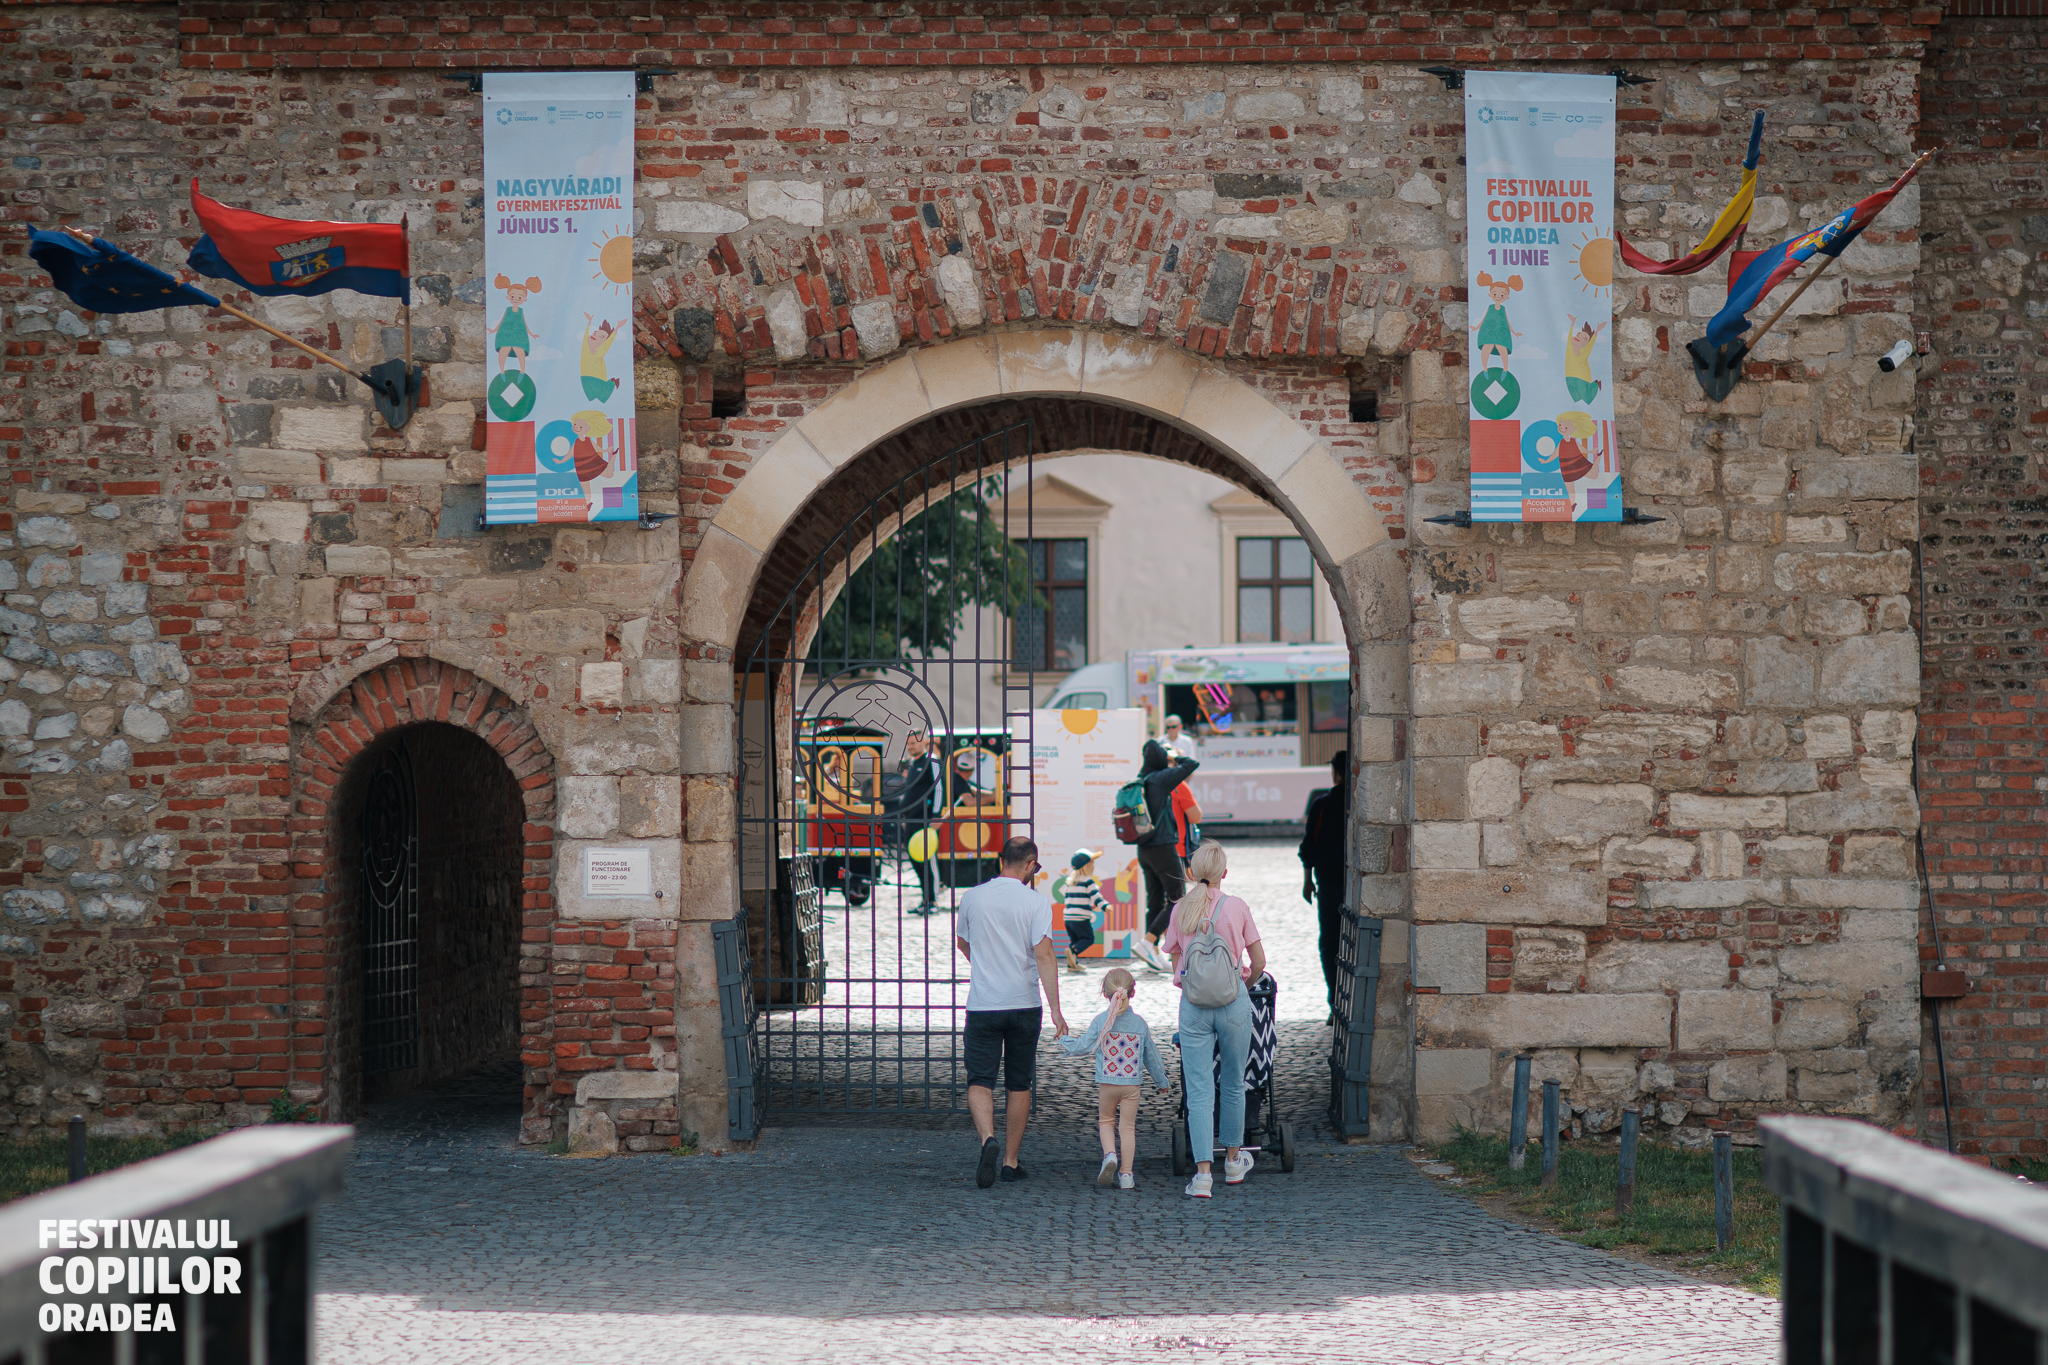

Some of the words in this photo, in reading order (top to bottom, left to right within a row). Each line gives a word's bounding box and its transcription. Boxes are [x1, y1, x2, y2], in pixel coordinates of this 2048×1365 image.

[496, 175, 622, 196] NAGYVÁRADI
[1486, 178, 1592, 198] FESTIVALUL
[496, 196, 622, 212] GYERMEKFESZTIVÁL
[1487, 200, 1594, 224] COPIILOR
[497, 215, 560, 234] JÚNIUS
[564, 218, 578, 234] 1.
[1487, 226, 1560, 245] ORADEA
[1488, 249, 1497, 266] 1
[1502, 249, 1550, 266] IUNIE
[544, 488, 578, 496] DIGI
[1236, 749, 1274, 758] BUBBLE
[1242, 780, 1282, 802] Tea
